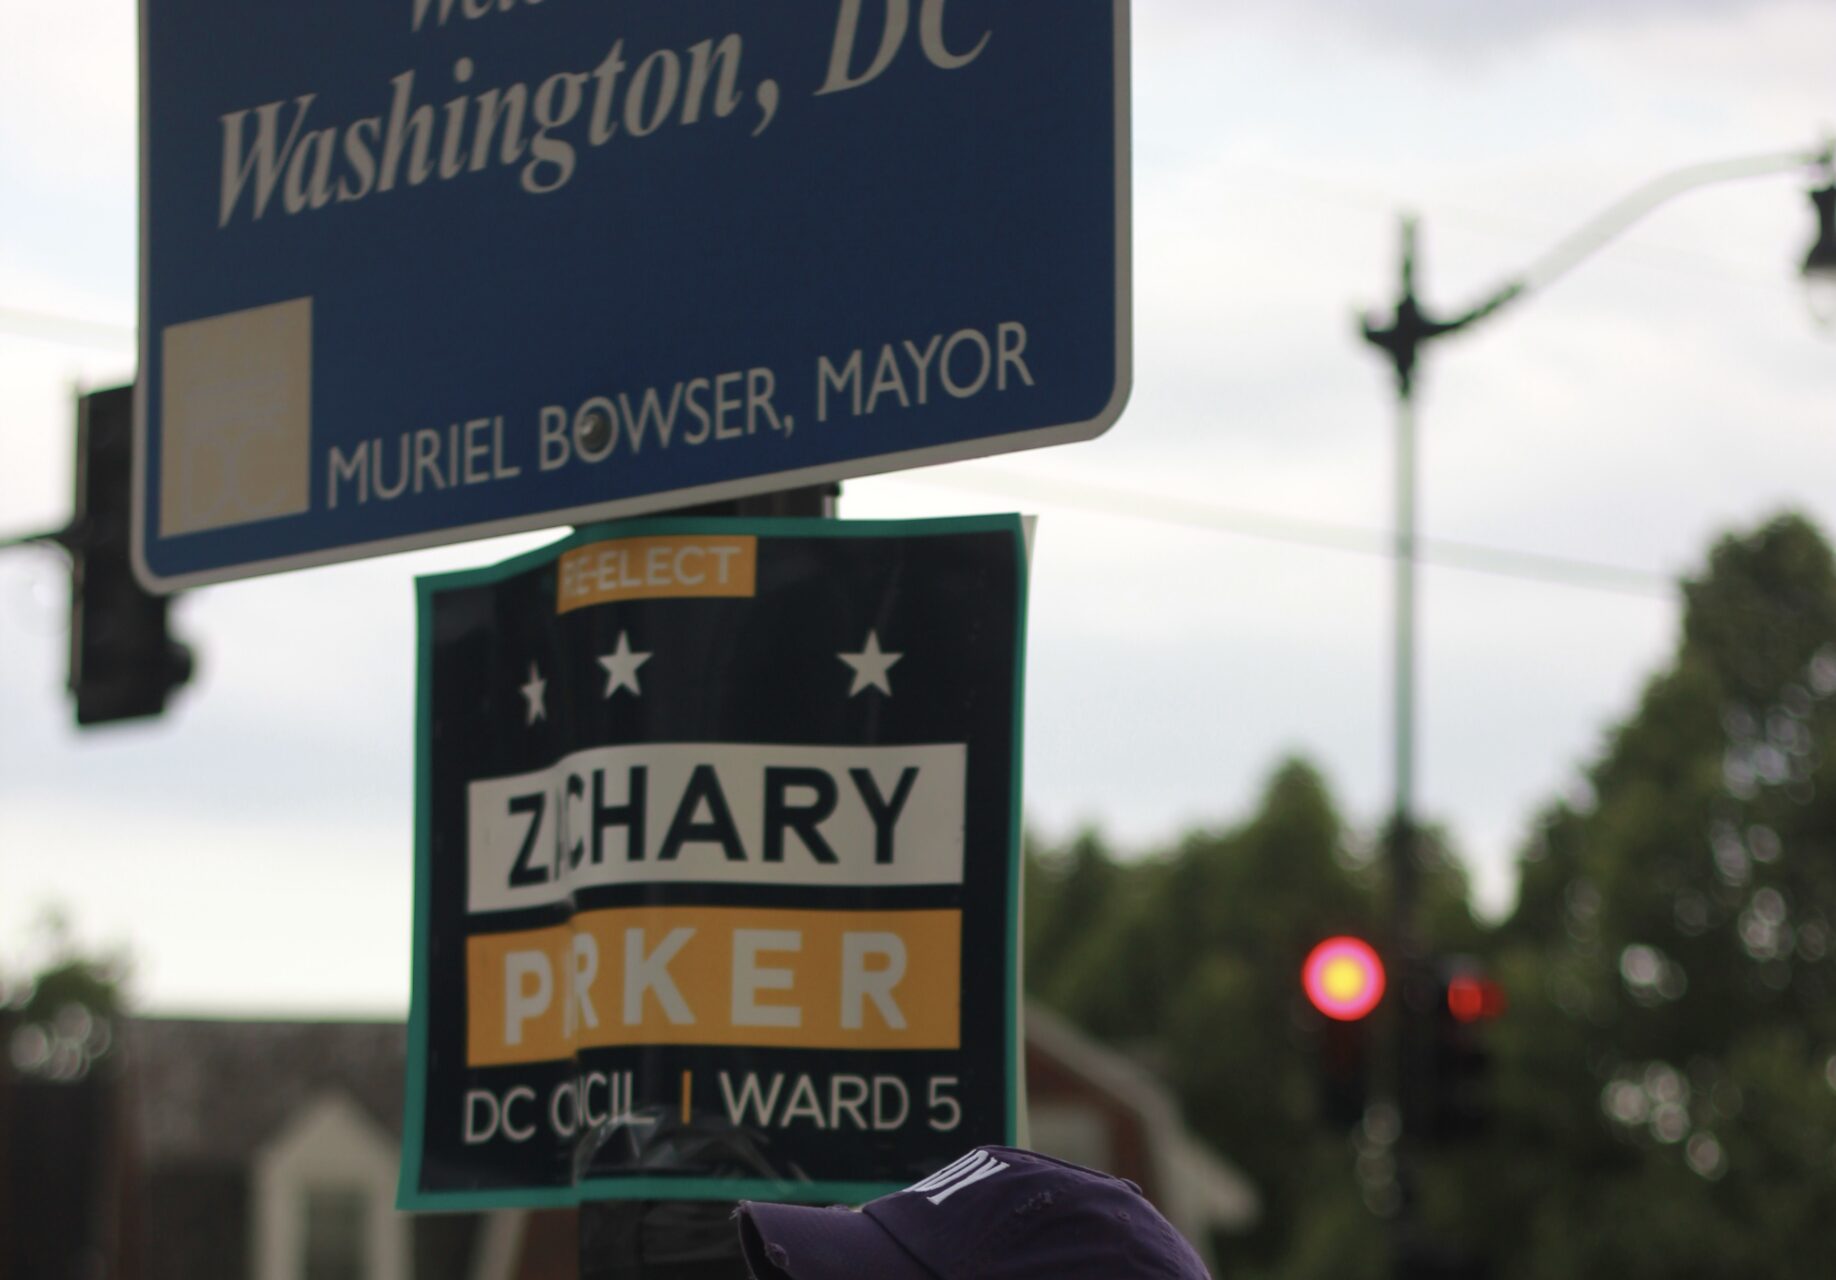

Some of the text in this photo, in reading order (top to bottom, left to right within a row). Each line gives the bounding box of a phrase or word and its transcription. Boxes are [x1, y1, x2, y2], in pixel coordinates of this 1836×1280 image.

[217, 0, 992, 228] Washington, DC
[327, 321, 1035, 509] MURIEL BOWSER, MAYOR
[507, 763, 921, 890] ZCHARY
[503, 926, 909, 1047] PRKER
[463, 1085, 536, 1144] DC
[719, 1070, 910, 1130] WARD
[927, 1076, 962, 1131] 5
